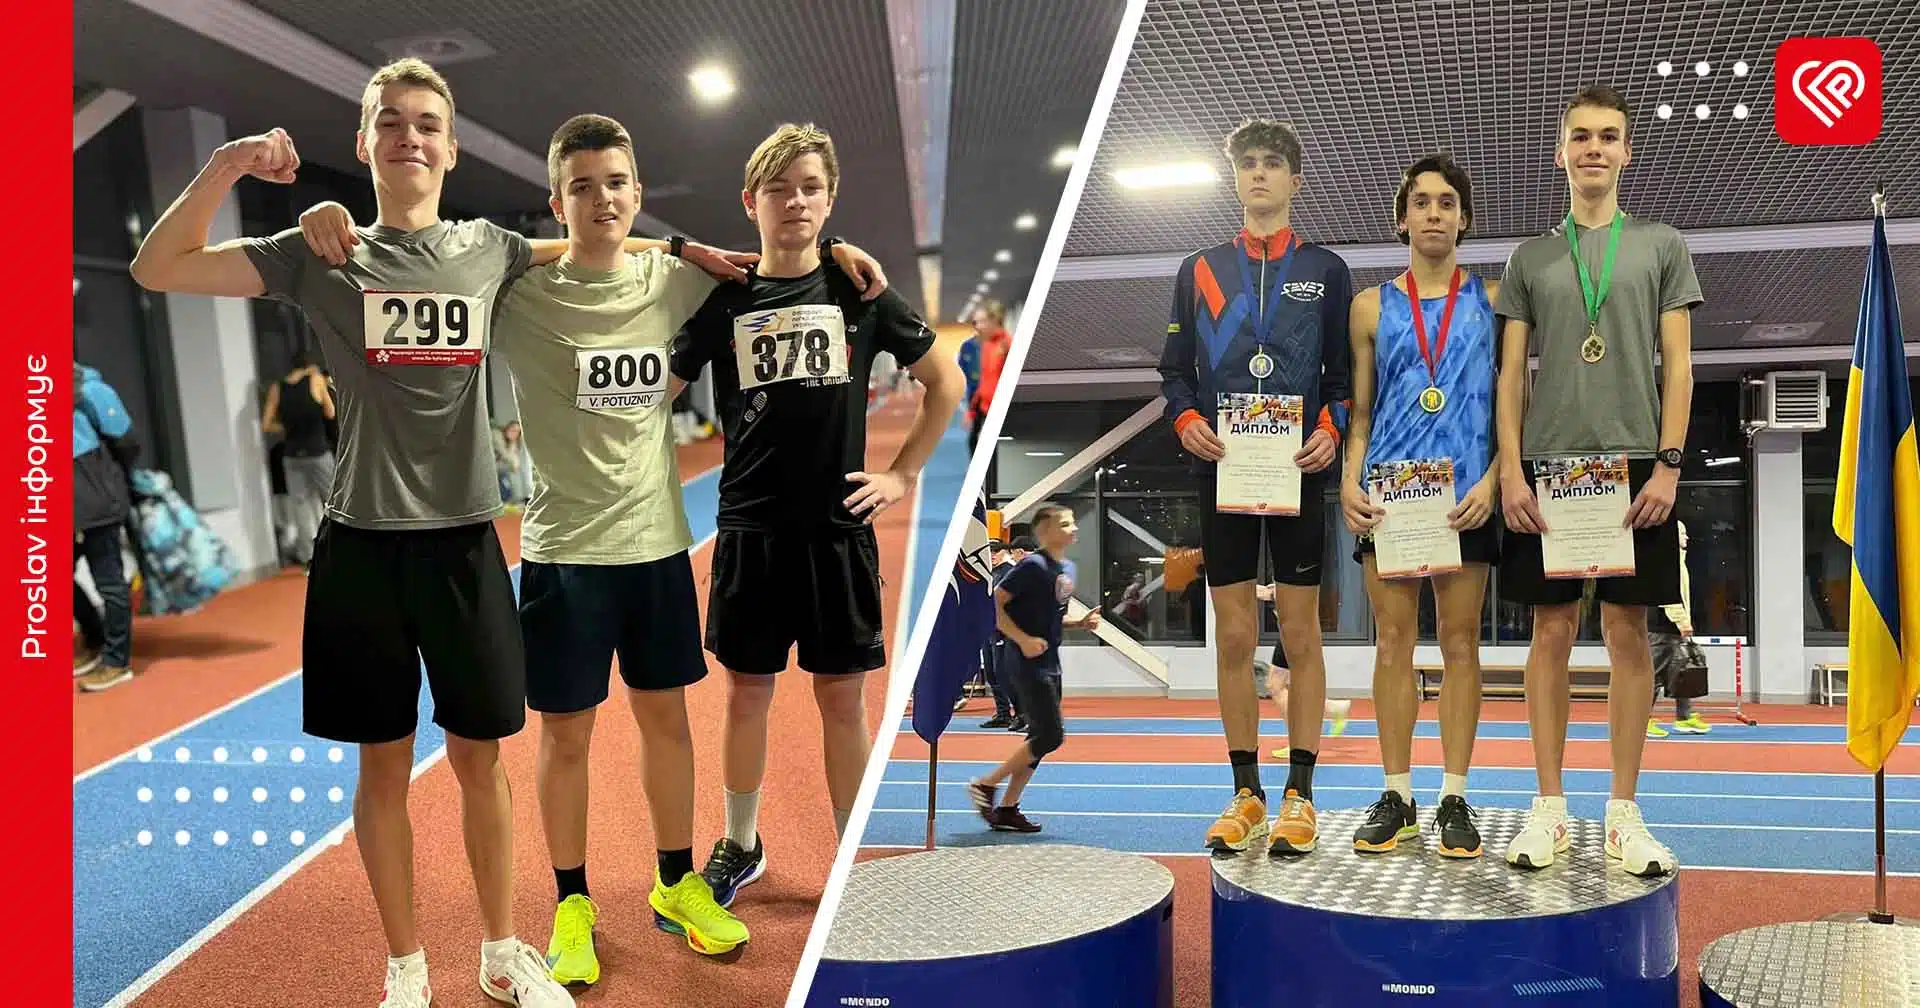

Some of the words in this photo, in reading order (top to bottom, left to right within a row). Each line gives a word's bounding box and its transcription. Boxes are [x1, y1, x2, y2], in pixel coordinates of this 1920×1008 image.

[382, 297, 469, 346] 299
[751, 328, 830, 382] 378
[588, 353, 661, 389] 800
[589, 397, 599, 407] V.
[602, 394, 654, 407] POTUZNIY
[1230, 423, 1290, 435] ДИПЛОМ
[1383, 487, 1442, 503] ДИПЛОМ
[1552, 485, 1616, 500] ДИПЛОМ
[1390, 983, 1436, 994] MONDO
[848, 997, 890, 1006] MONDO
